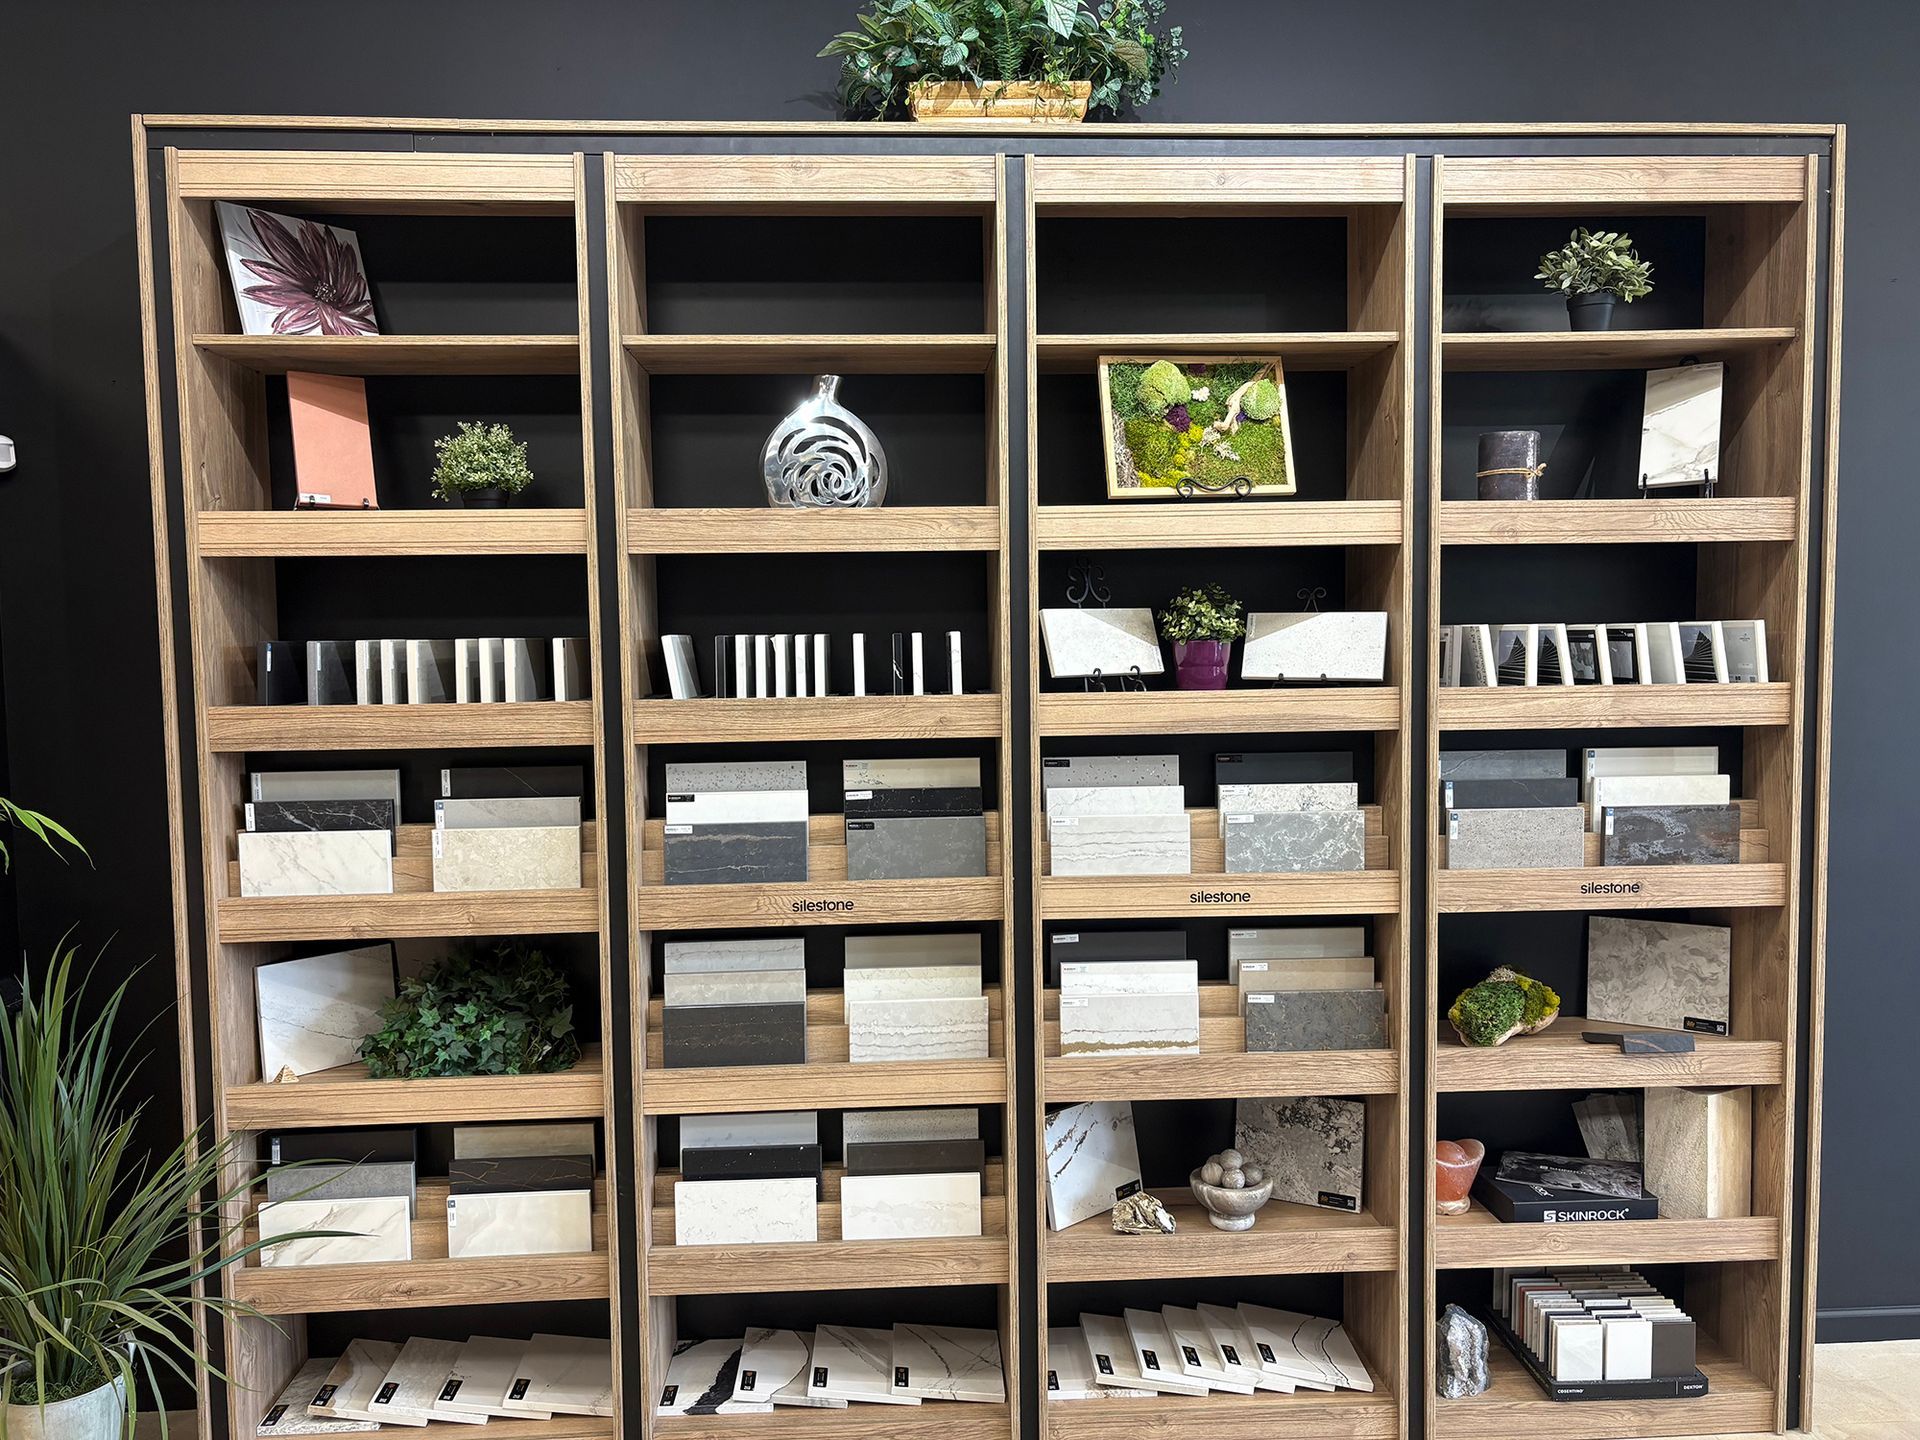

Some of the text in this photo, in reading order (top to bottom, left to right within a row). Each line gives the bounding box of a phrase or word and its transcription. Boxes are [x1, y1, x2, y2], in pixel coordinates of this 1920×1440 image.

[1580, 882, 1640, 894] silestone
[1190, 890, 1251, 903] silestone
[792, 899, 854, 912] silestone
[1558, 1211, 1626, 1222] SKINROCK
